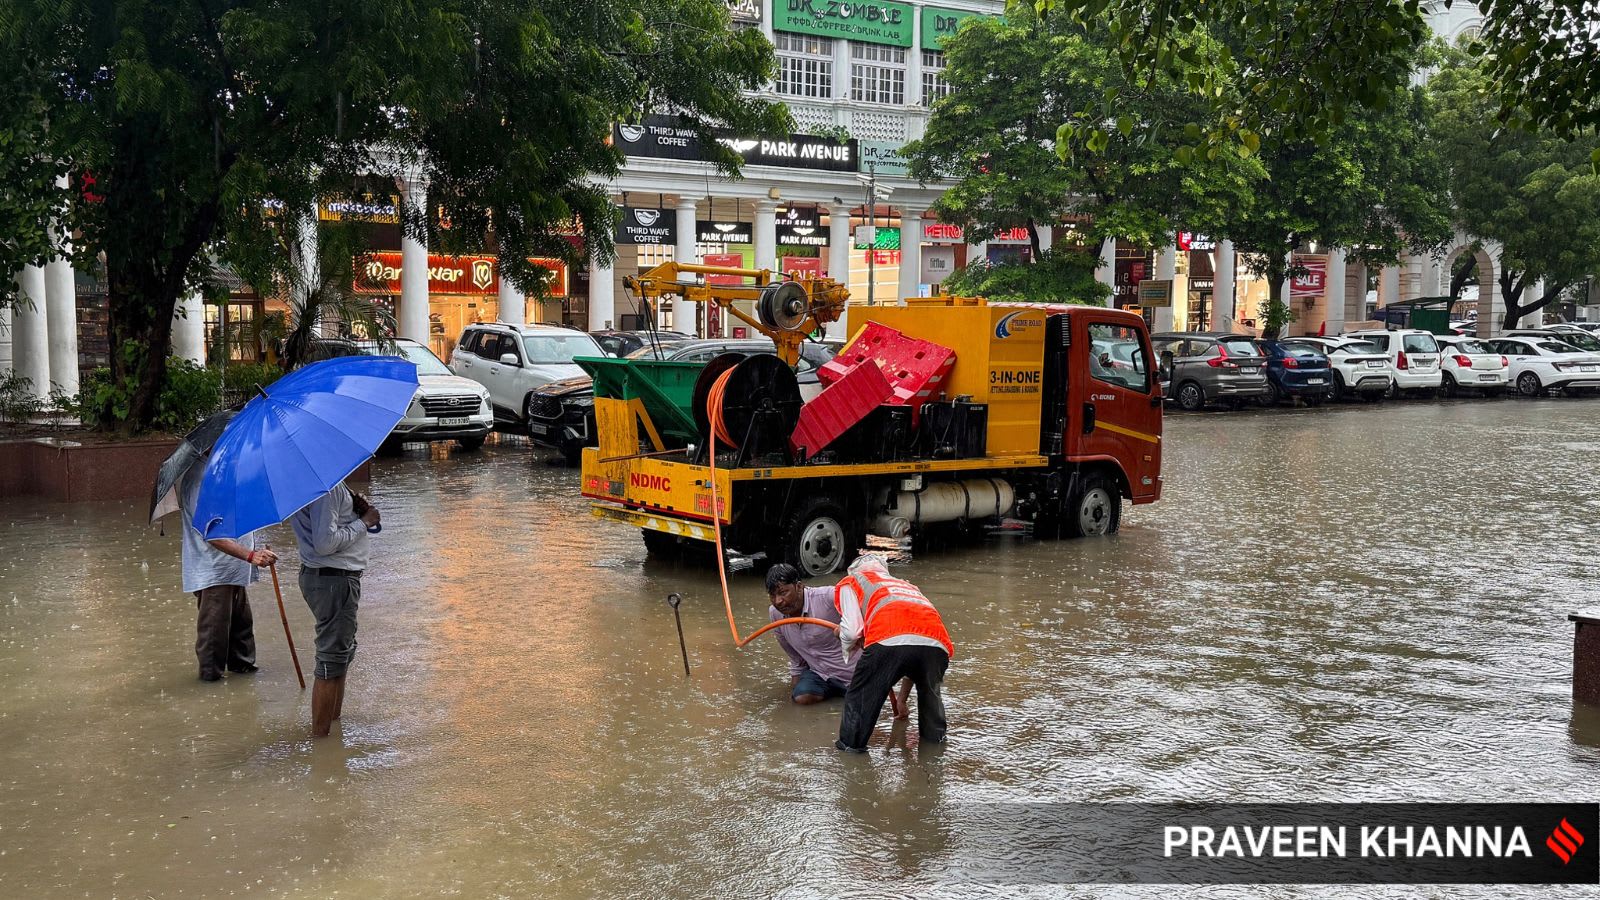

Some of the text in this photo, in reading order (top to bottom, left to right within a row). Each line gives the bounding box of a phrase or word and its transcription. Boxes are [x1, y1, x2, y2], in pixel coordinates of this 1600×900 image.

[883, 31, 900, 39] LAB
[649, 125, 698, 138] THIRD WAVE
[657, 136, 687, 147] COFFEE
[761, 140, 850, 161] PARK AVENUE
[626, 226, 669, 236] THIRD WAVE
[925, 223, 963, 239] METRO
[634, 235, 660, 243] COFFEE
[701, 232, 749, 243] PARK AVENUE
[781, 235, 827, 246] PARK AVENUE
[1295, 274, 1320, 286] SALE
[990, 371, 1040, 384] 3-IN-ONE
[630, 472, 671, 492] NDMC
